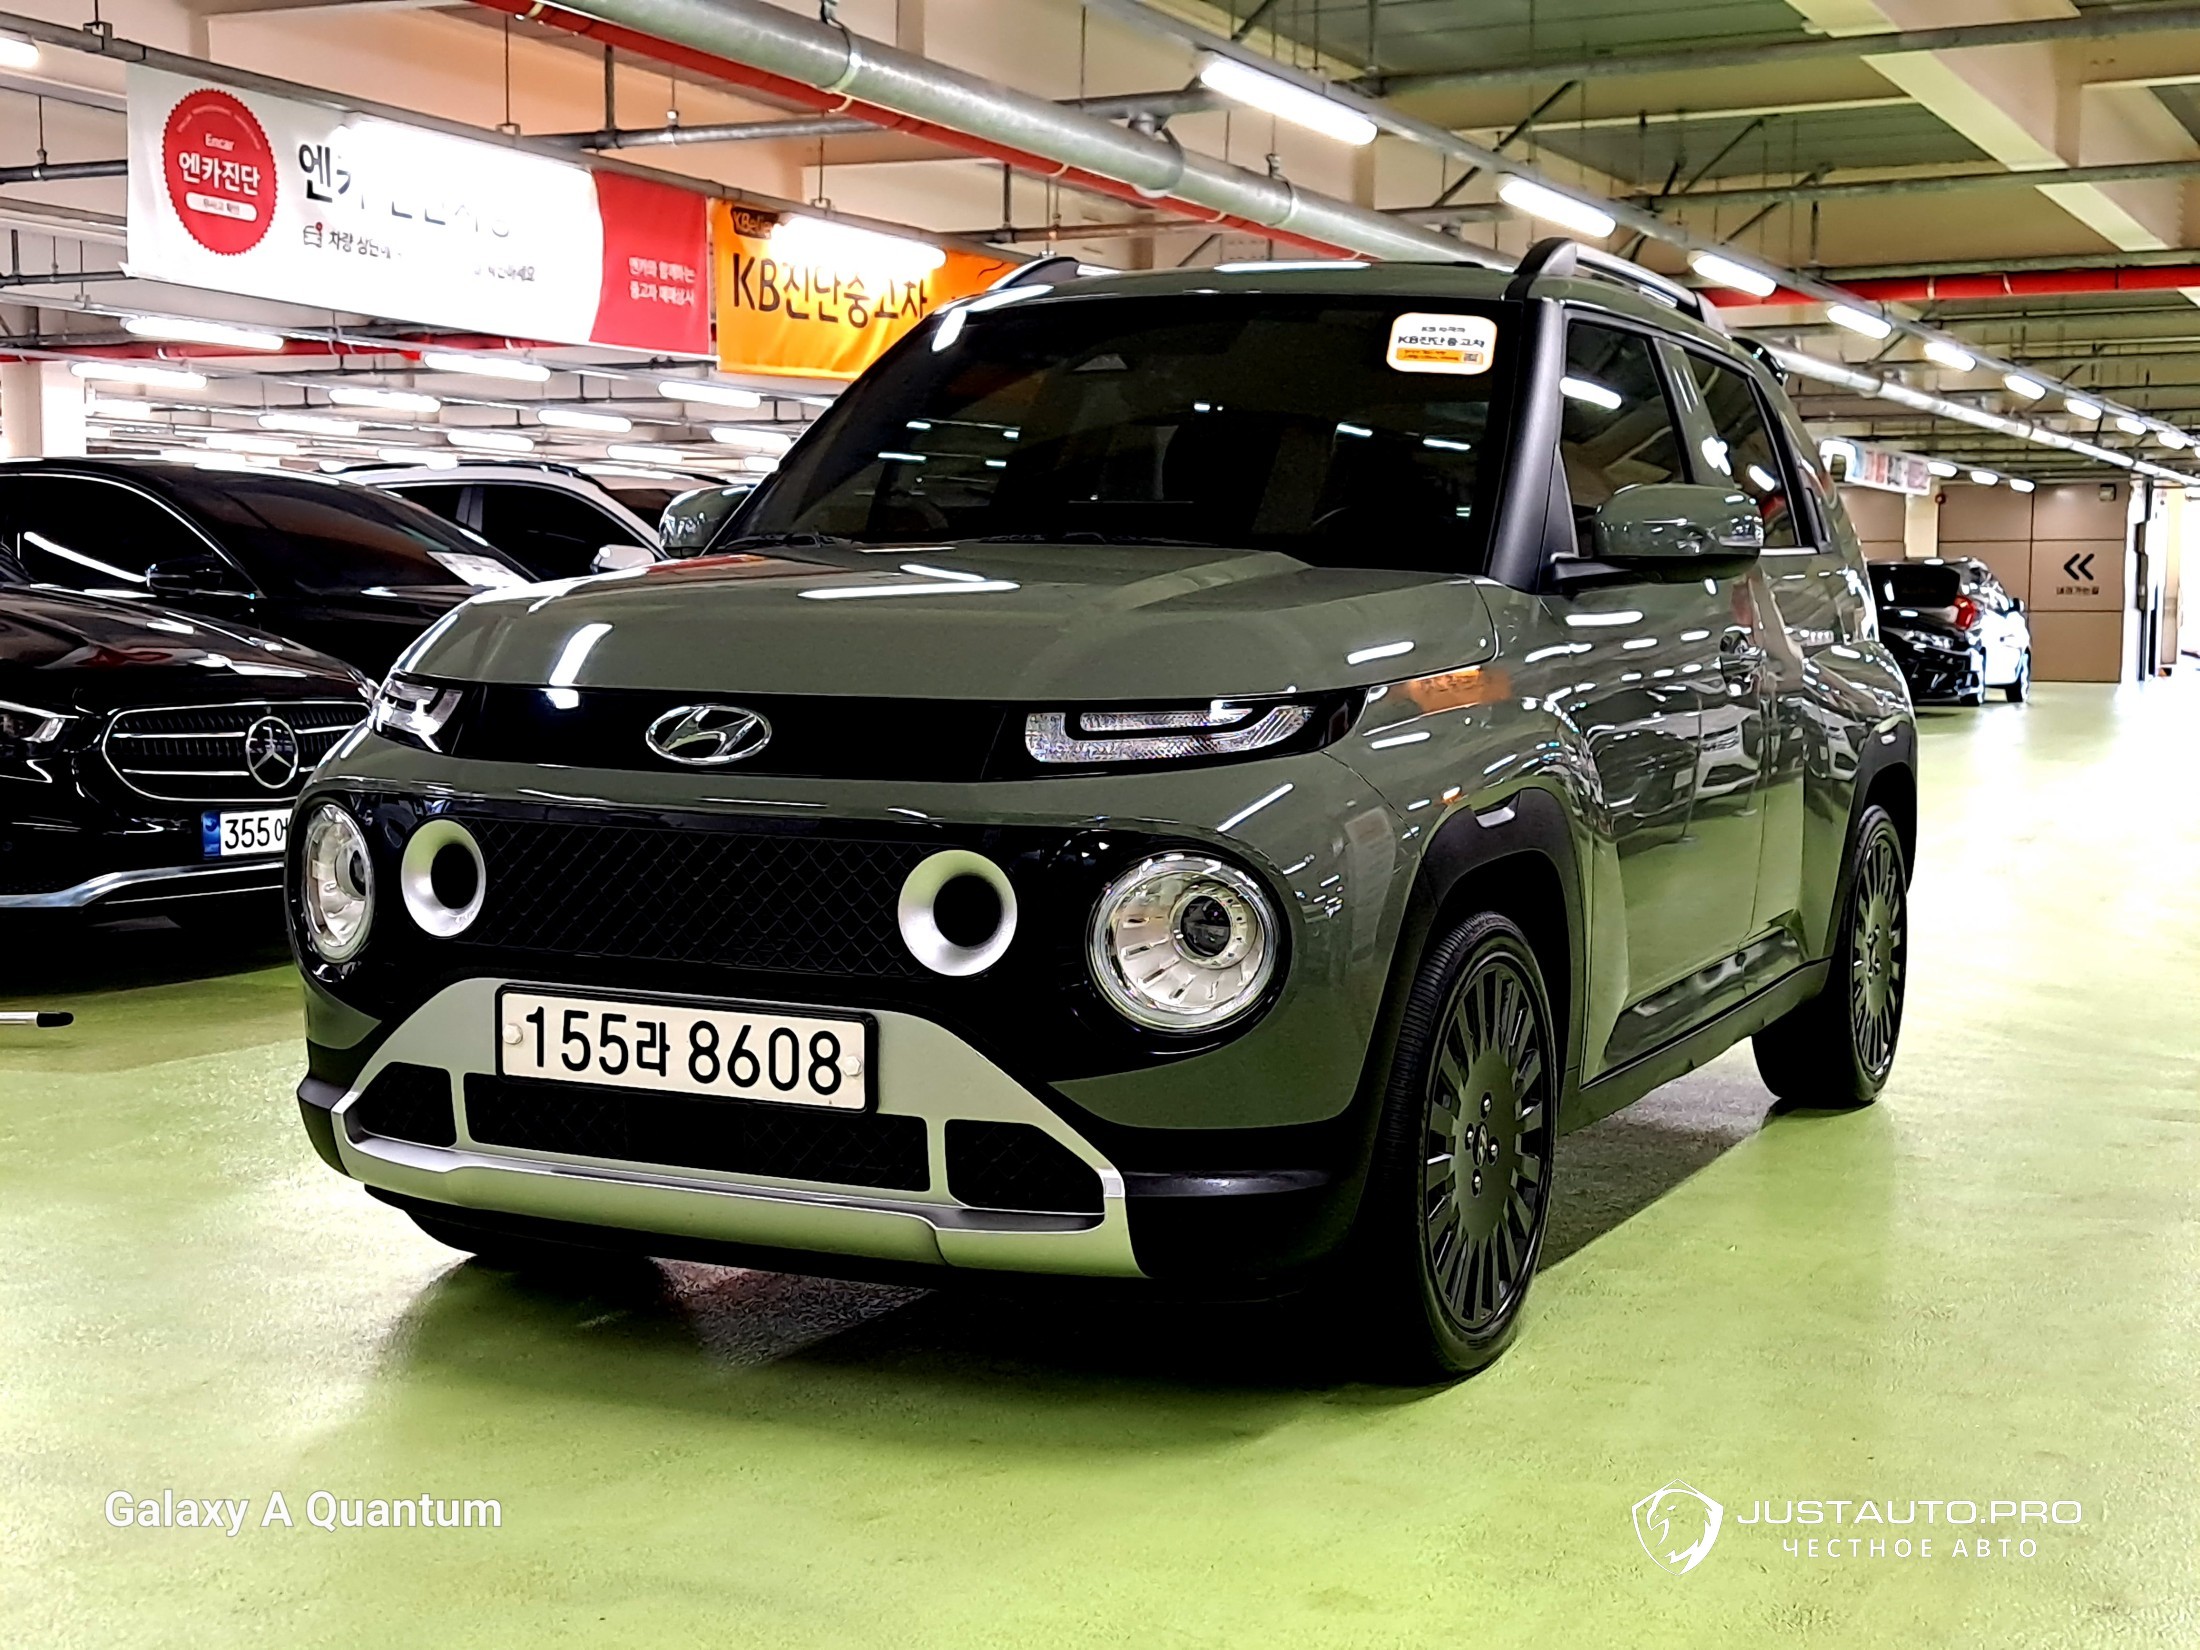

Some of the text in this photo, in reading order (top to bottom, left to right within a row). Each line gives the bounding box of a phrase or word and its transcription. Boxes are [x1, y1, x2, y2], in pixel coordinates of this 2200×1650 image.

[178, 152, 261, 196] 엔카진단
[525, 1006, 843, 1096] 155라 8608
